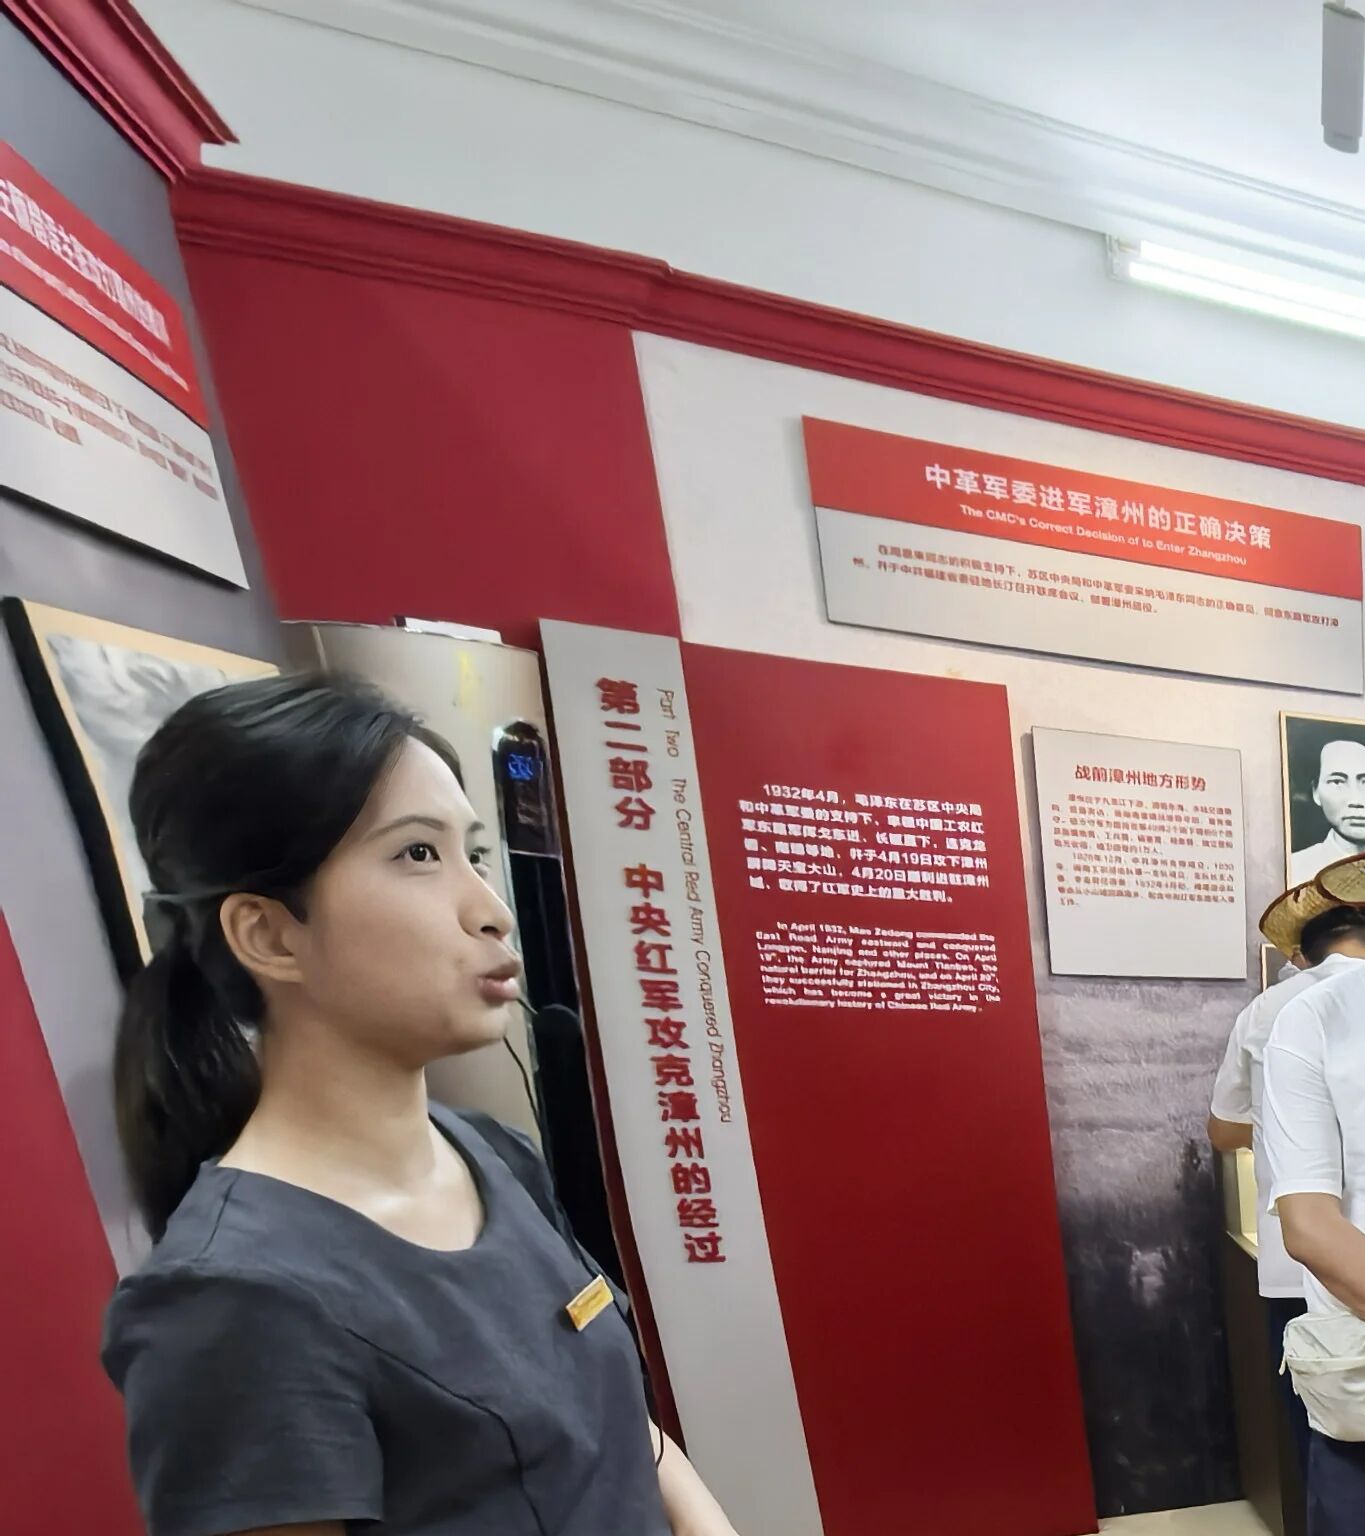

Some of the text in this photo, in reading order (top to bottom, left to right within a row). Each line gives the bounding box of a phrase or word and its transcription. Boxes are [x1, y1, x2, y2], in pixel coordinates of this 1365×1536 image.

[925, 463, 1272, 550] 中革军委进军漳州的正确决策
[959, 504, 1247, 566] The CMC's Correct Decision of to Enter Zhangzhou
[657, 687, 676, 721] Part
[664, 729, 680, 758] Two
[672, 778, 687, 804] The
[1075, 764, 1206, 792] 战前漳州地方形势
[676, 808, 695, 871] Central
[684, 871, 701, 902] Red
[688, 905, 704, 945] Army
[595, 677, 726, 1263] 第二部分 中央红军攻克漳州的经过
[695, 950, 722, 1038] Conquered
